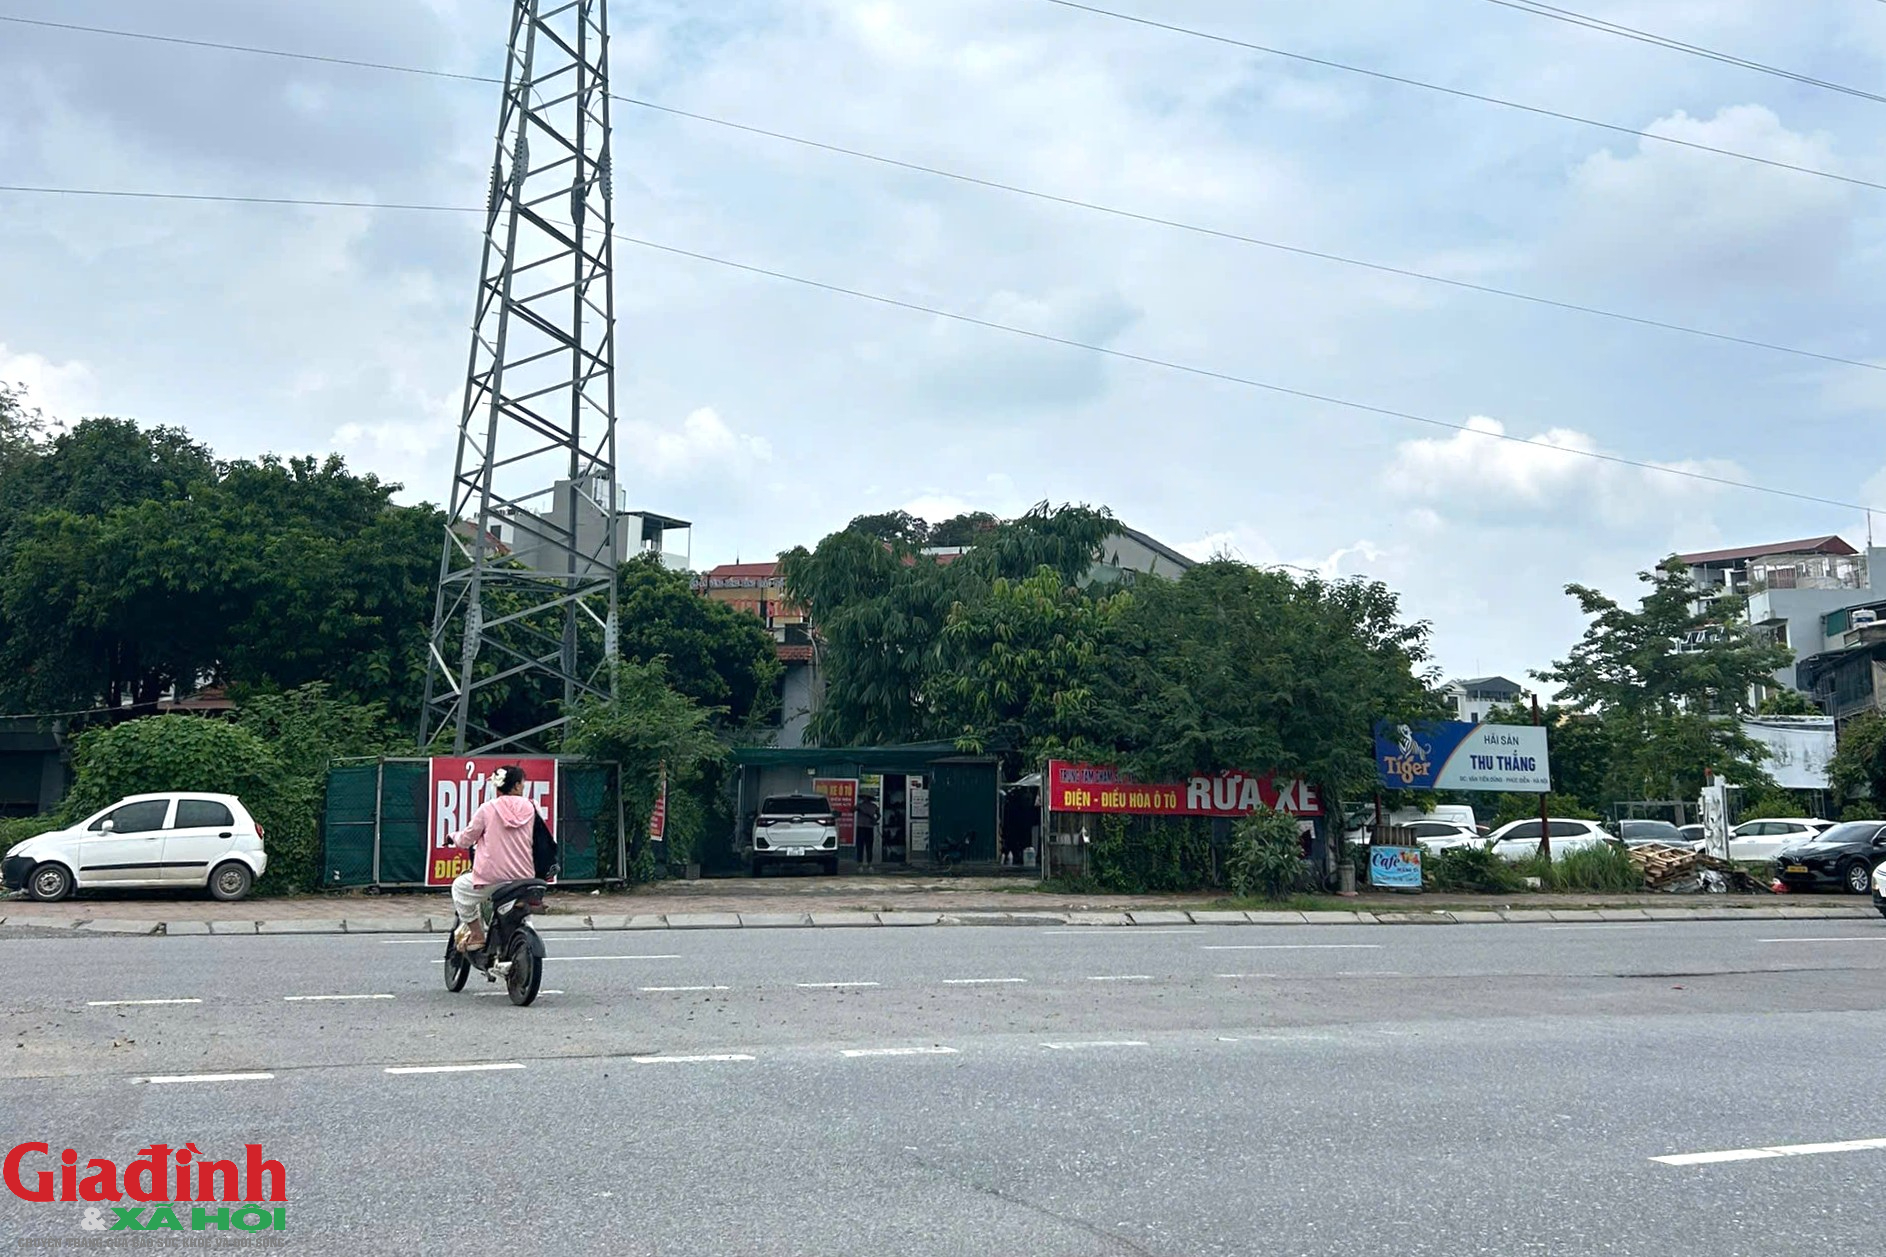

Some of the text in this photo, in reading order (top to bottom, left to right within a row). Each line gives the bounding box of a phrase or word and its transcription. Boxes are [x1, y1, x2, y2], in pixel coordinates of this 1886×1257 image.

[1484, 733, 1519, 746] HẢI SẢN
[1384, 755, 1431, 784] Tiger
[1470, 749, 1536, 772] THU THẮNG
[1064, 788, 1091, 810] ĐIỆN
[1101, 787, 1126, 808] ĐIỀU
[1129, 789, 1151, 808] HÒA
[1154, 790, 1161, 808] Ô
[1164, 791, 1177, 808] TÔ
[1187, 769, 1262, 810] RỬA
[1274, 780, 1318, 811] XE
